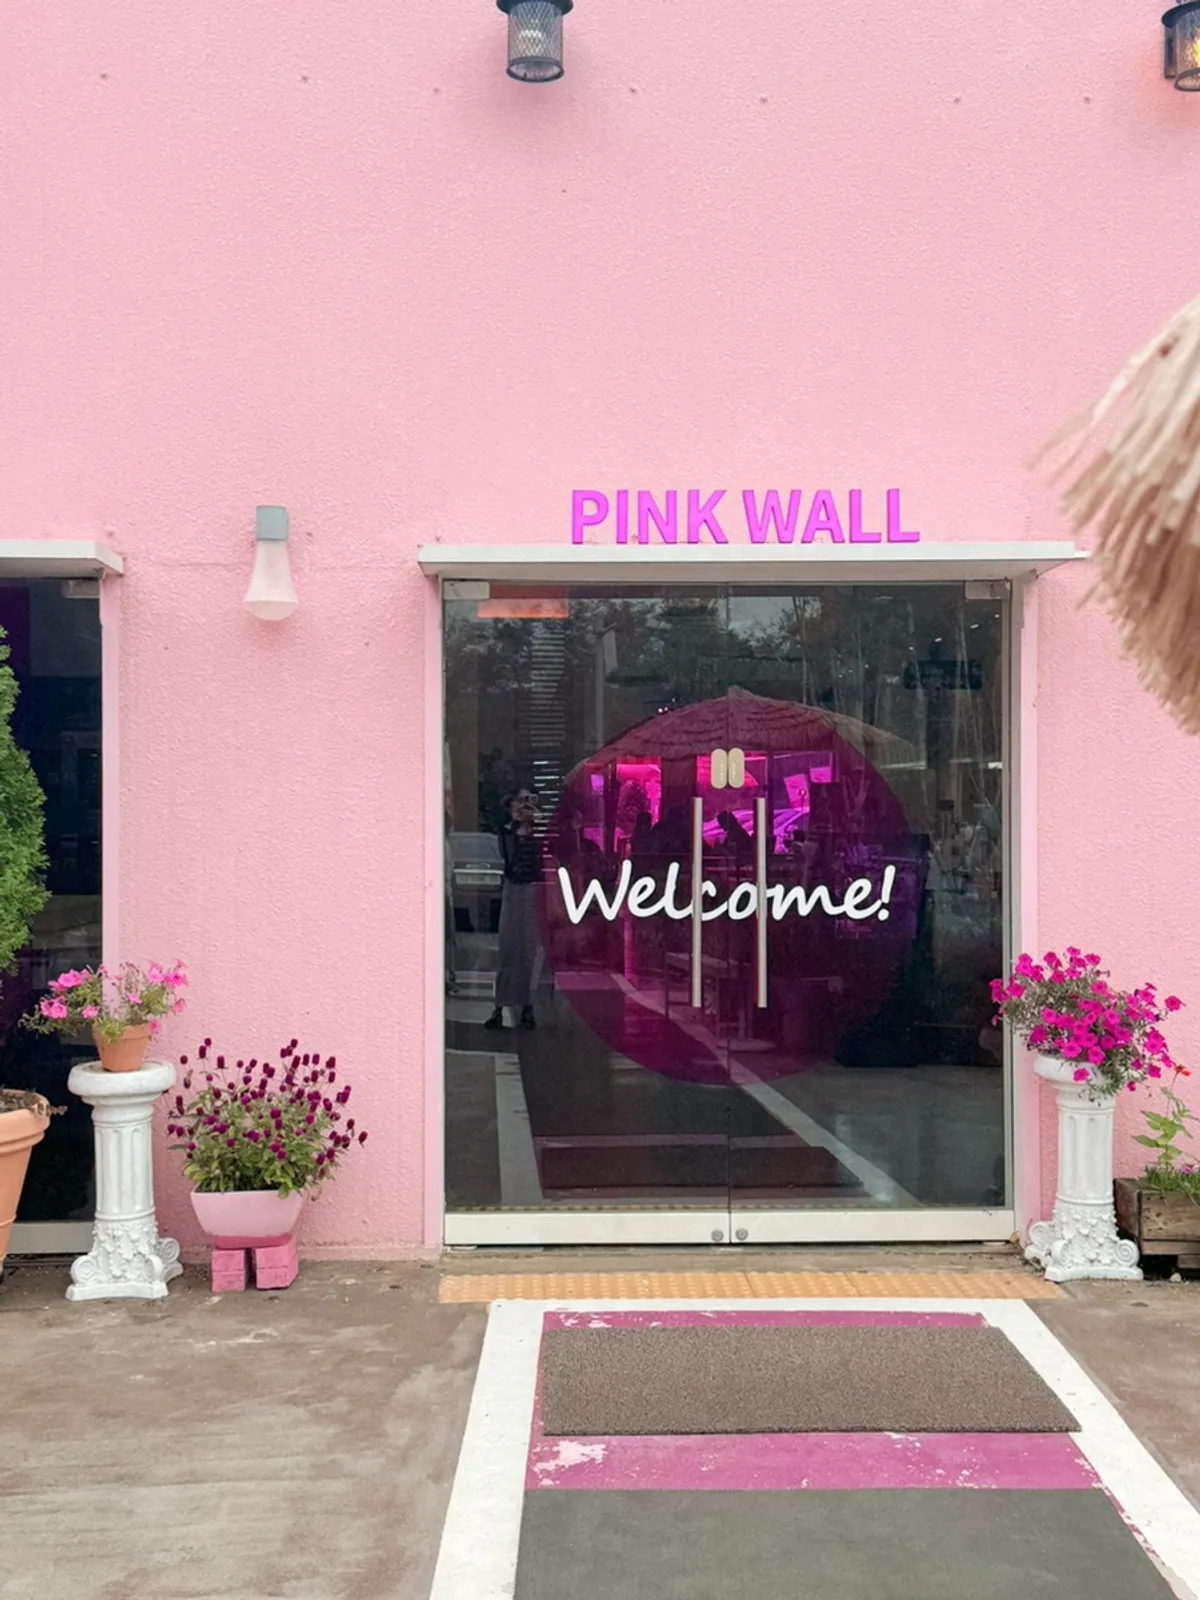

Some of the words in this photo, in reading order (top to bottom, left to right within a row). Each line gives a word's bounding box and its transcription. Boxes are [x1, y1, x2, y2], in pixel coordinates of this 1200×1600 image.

[571, 489, 729, 544] PINK
[741, 488, 920, 543] WALL
[557, 859, 896, 924] Welcome!
